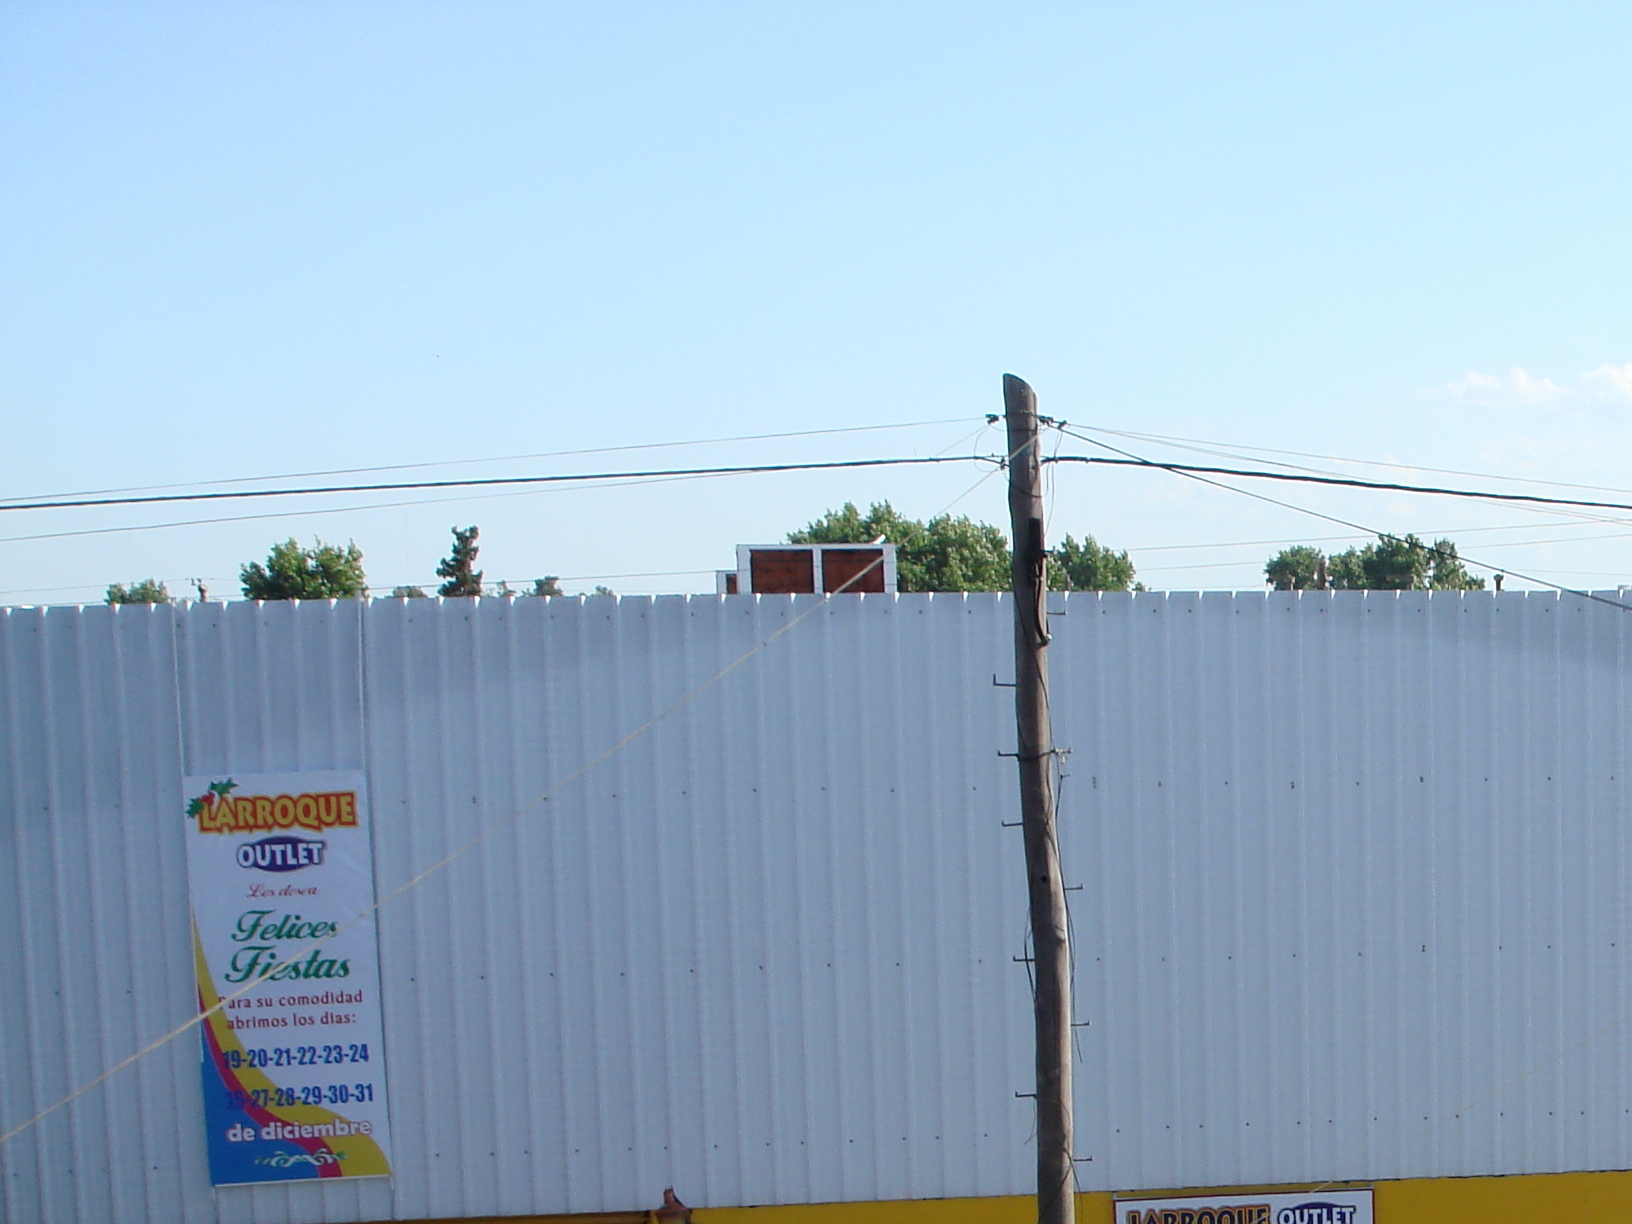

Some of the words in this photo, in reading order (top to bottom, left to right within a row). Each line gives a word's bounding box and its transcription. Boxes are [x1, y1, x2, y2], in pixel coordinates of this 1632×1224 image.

[199, 792, 358, 834] LARROQUE
[237, 839, 326, 869] OUTLET
[231, 909, 339, 942] Felices
[224, 945, 350, 983] Fiestas
[257, 997, 273, 1008] su
[279, 989, 363, 1007] comodidad
[227, 1015, 288, 1030] abrimos
[293, 1013, 315, 1026] los
[223, 1044, 369, 1069] 19-20-21-22-23-24
[228, 1123, 255, 1142] de
[261, 1118, 372, 1141] diciembre
